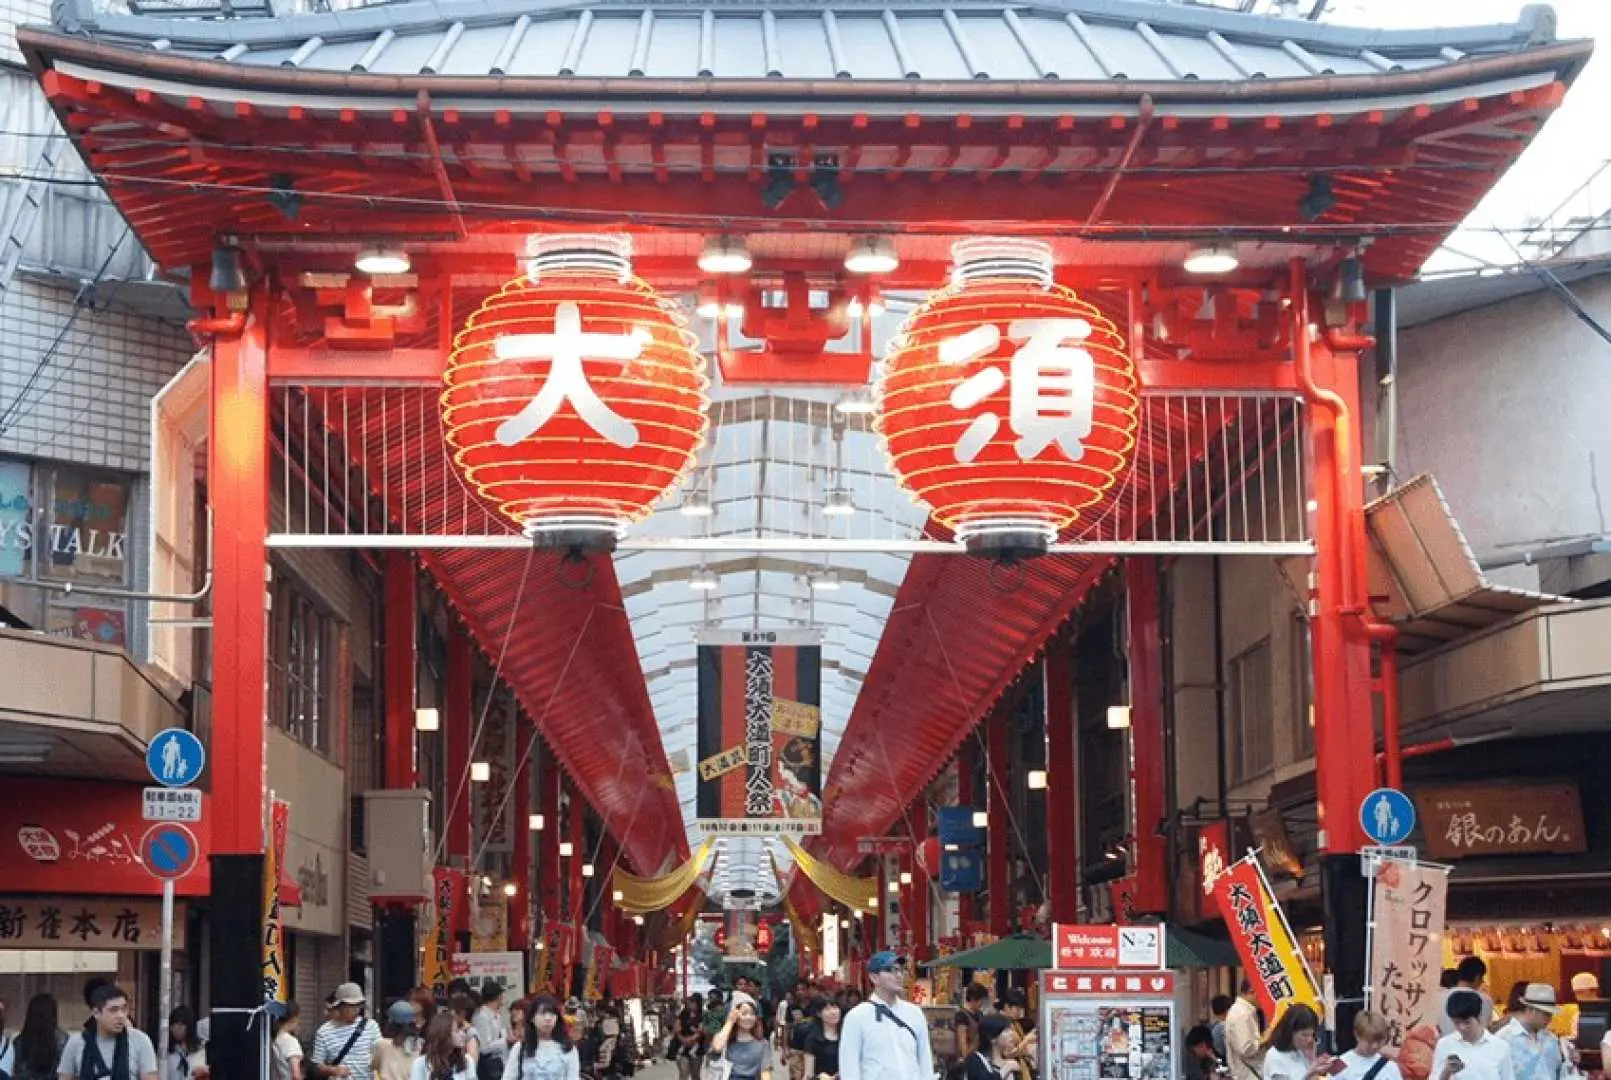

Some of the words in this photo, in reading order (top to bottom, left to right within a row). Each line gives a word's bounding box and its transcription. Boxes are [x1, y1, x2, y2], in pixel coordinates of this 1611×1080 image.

[495, 302, 653, 448] 大
[938, 318, 1094, 462] 須
[50, 523, 129, 561] TALK
[0, 905, 142, 945] 新雀本店
[1404, 878, 1433, 1032] クロワッサン
